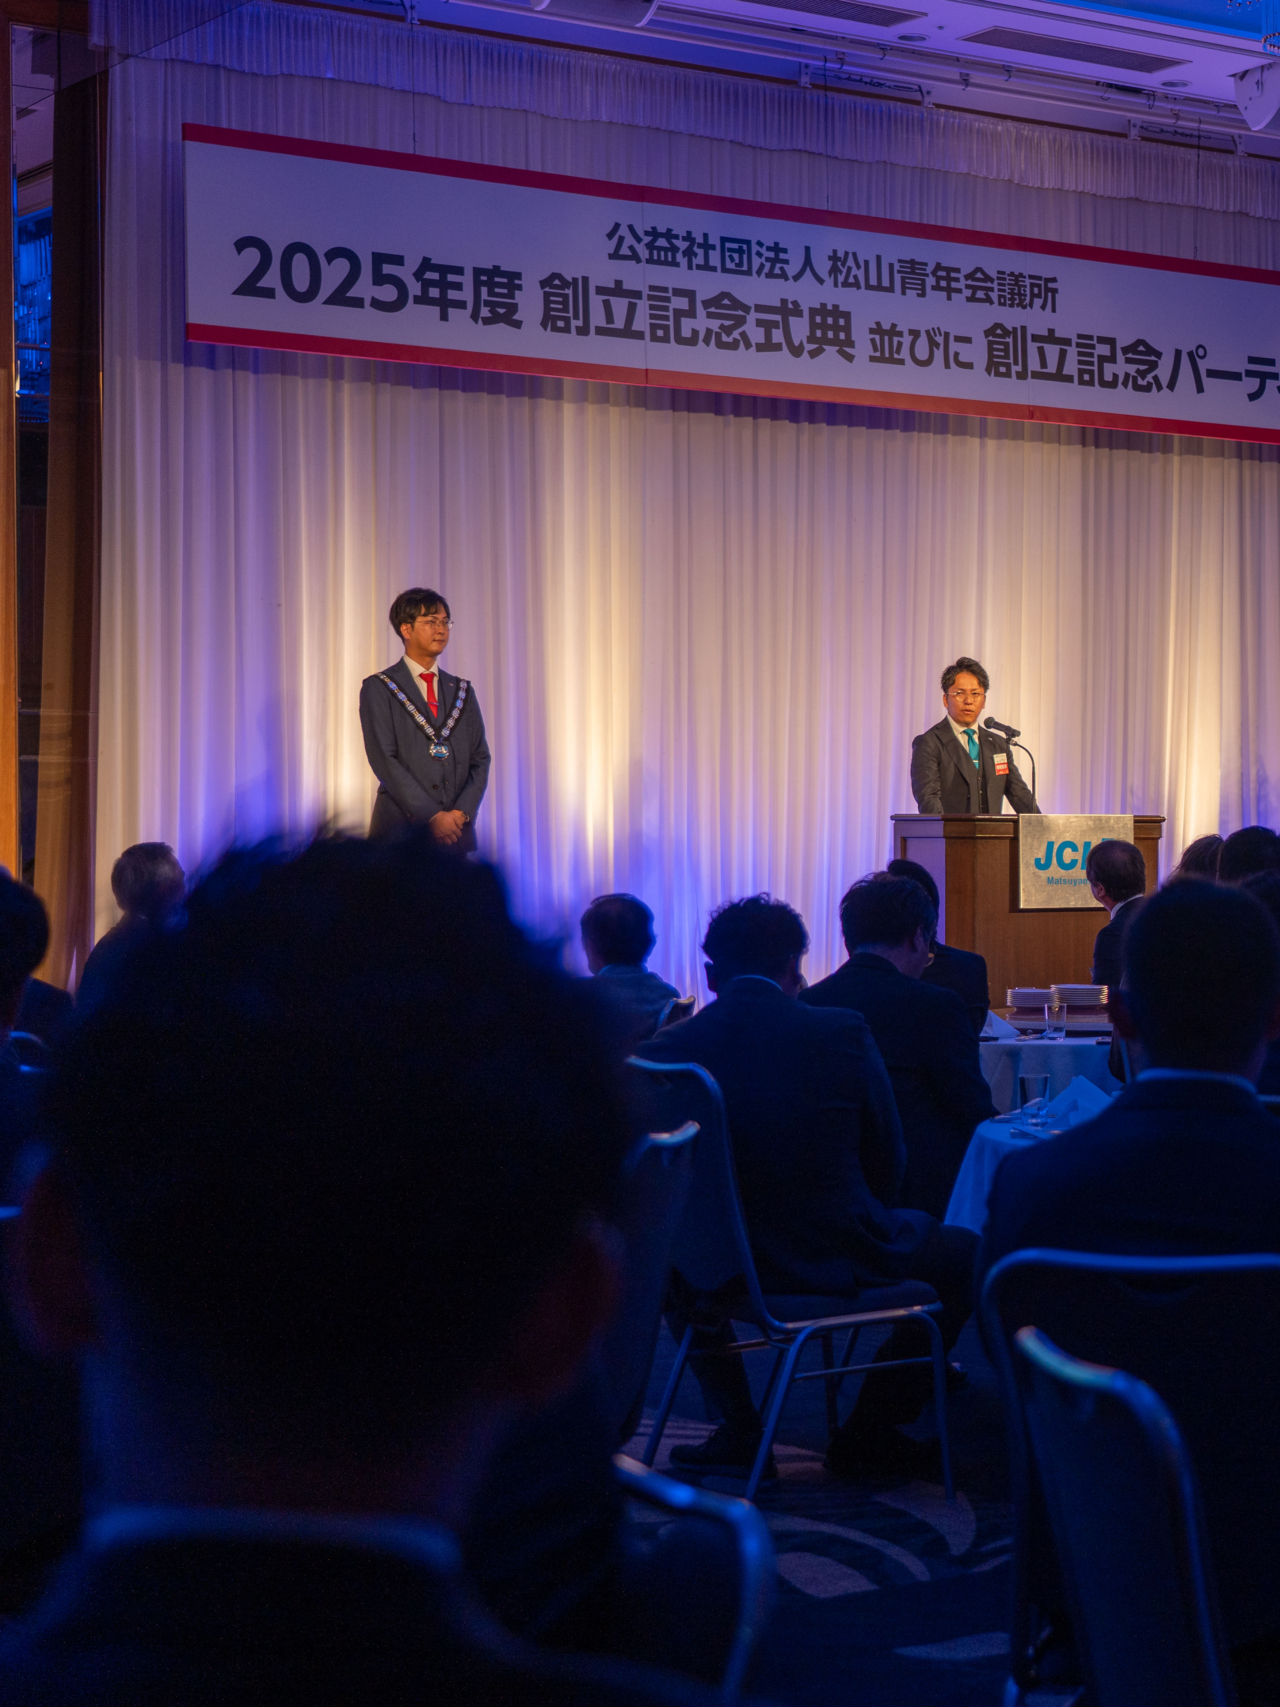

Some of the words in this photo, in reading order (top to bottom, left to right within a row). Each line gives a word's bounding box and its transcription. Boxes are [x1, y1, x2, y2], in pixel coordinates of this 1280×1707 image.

[231, 234, 523, 330] 2025年度
[539, 272, 855, 363] 創立記念式典
[869, 320, 974, 370] 並びに
[606, 221, 1058, 314] 公益社団法人松山青年会議所
